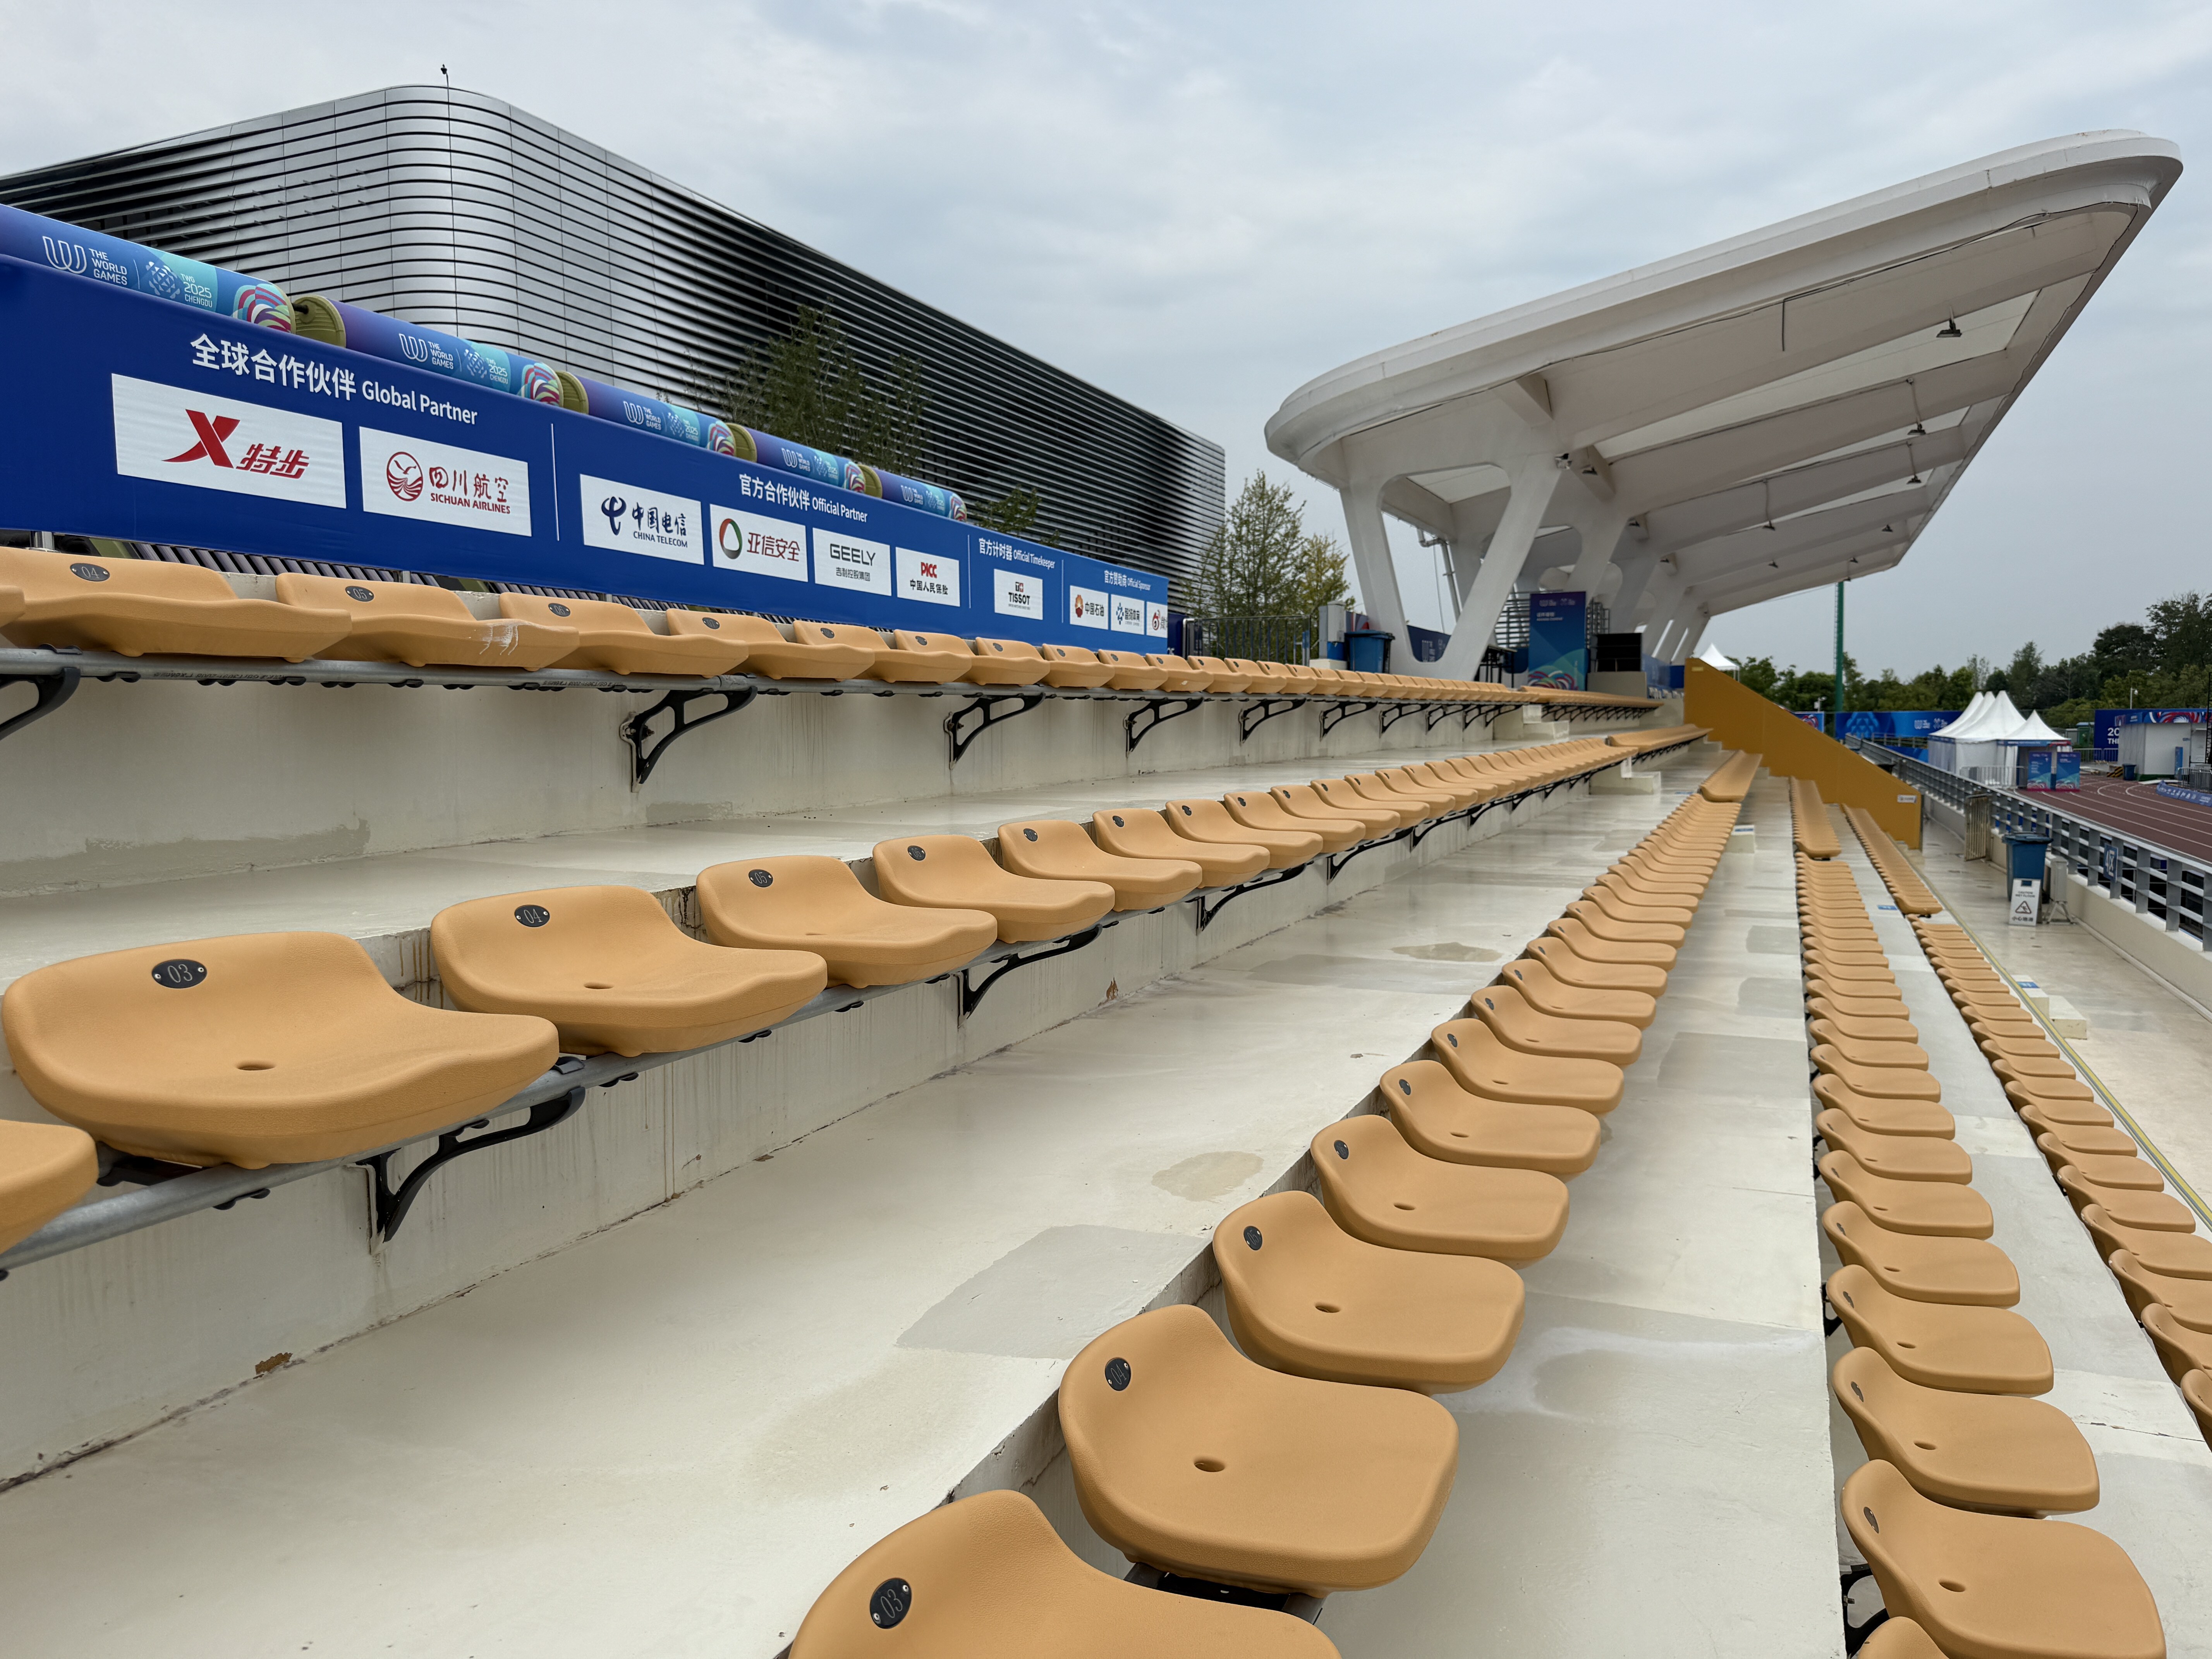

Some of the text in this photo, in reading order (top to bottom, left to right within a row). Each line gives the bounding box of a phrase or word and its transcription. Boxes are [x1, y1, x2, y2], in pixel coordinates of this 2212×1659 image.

[89, 248, 109, 261] THE
[91, 257, 127, 275] WORLD
[93, 268, 127, 286] GAMES
[180, 273, 195, 283] TWG
[184, 281, 212, 299] 2025
[185, 294, 213, 308] CHENGDU
[428, 341, 441, 351] THE
[430, 349, 453, 361] WORLD
[432, 356, 454, 369] GAMES
[489, 364, 508, 377] 2025
[191, 333, 478, 425] 全球合作伙伴 Global Partner
[645, 414, 661, 423] WORLD
[646, 421, 661, 431] GAMES
[235, 443, 309, 479] 特步
[429, 467, 509, 503] 四川航空
[431, 493, 511, 514] SICHUAN AIRLINES
[739, 474, 868, 523] 官方合作伙伴 Official Partner
[632, 502, 687, 537] 中国电信
[633, 531, 688, 548] CHINA TELECOM
[747, 532, 800, 562] 亚信安全
[830, 543, 876, 567] GEELY
[979, 538, 1055, 570] 官方计时器 Official Timekeeper
[81, 566, 100, 579] 04
[836, 567, 871, 582] 吉利控股集团
[921, 562, 938, 579] PICC
[353, 588, 367, 599] 05
[910, 579, 949, 596] 中国人民保险
[1008, 592, 1030, 605] TISSOT
[555, 605, 565, 615] 06
[912, 848, 921, 857] 06
[754, 872, 767, 884] 05
[524, 909, 543, 924] 04
[168, 964, 192, 983] 03
[1247, 1231, 1257, 1245] 05
[1111, 1364, 1128, 1385] 04
[880, 1590, 903, 1618] 03
